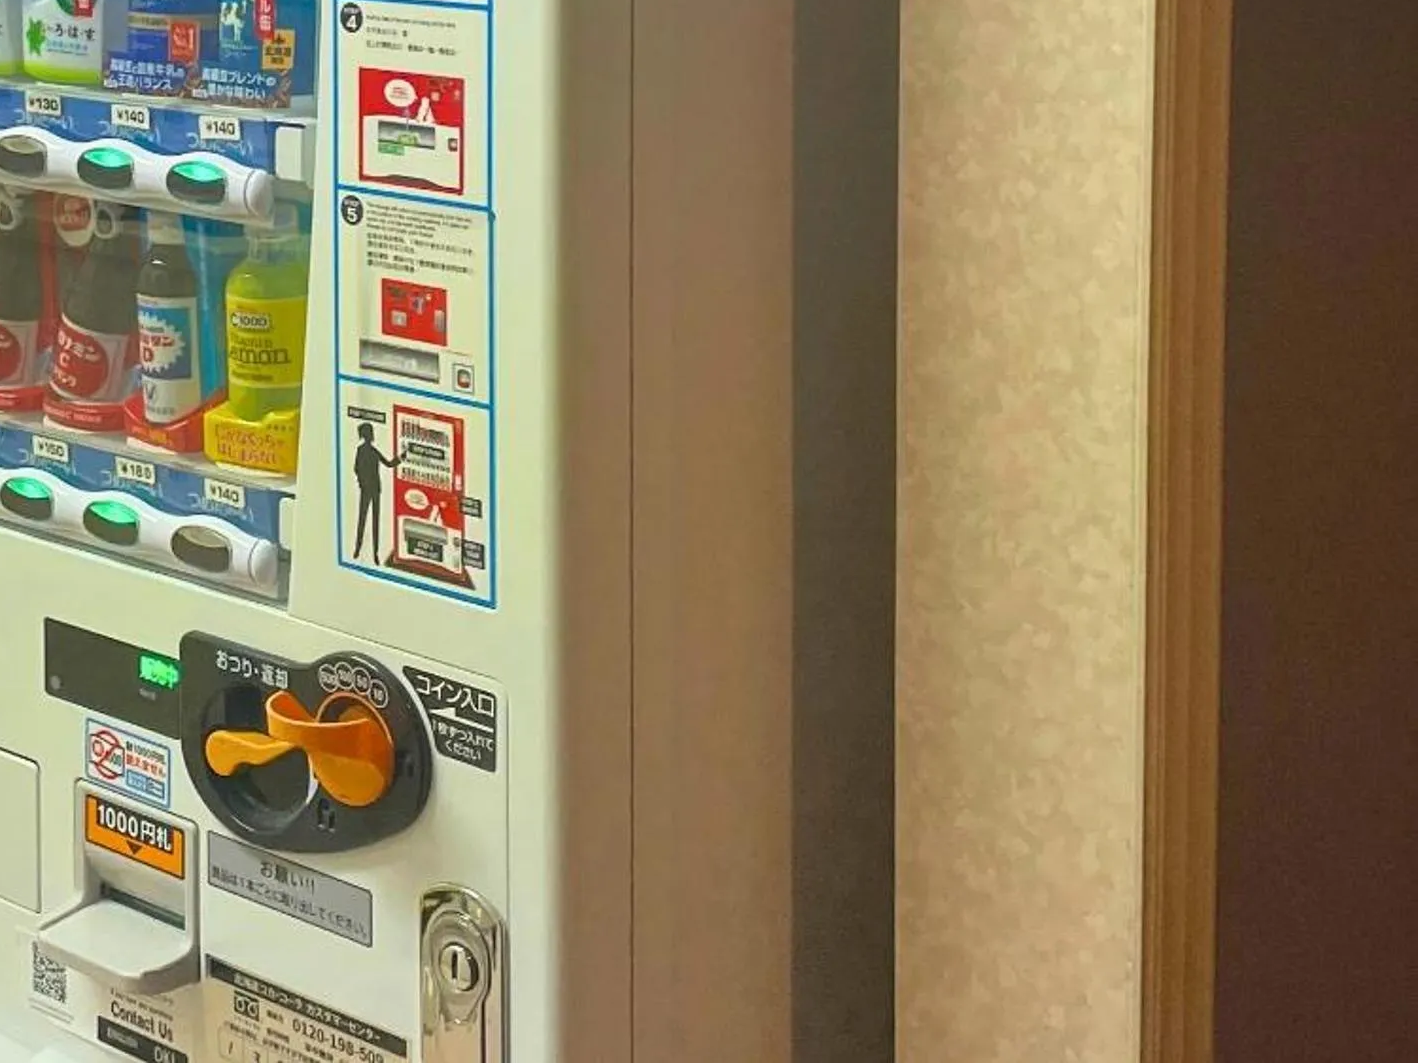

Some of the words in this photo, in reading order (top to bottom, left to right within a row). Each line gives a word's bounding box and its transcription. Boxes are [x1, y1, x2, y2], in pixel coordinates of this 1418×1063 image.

[346, 14, 358, 31] 4
[28, 97, 59, 112] ¥130
[116, 109, 144, 123] ¥140
[206, 120, 236, 136] ¥140
[346, 207, 358, 222] 5
[209, 485, 240, 503] ¥140
[416, 673, 495, 717] コイン入口
[444, 740, 482, 761] ください
[96, 802, 173, 852] 1000円札
[110, 1000, 155, 1035] Contact
[158, 1019, 175, 1043] Us
